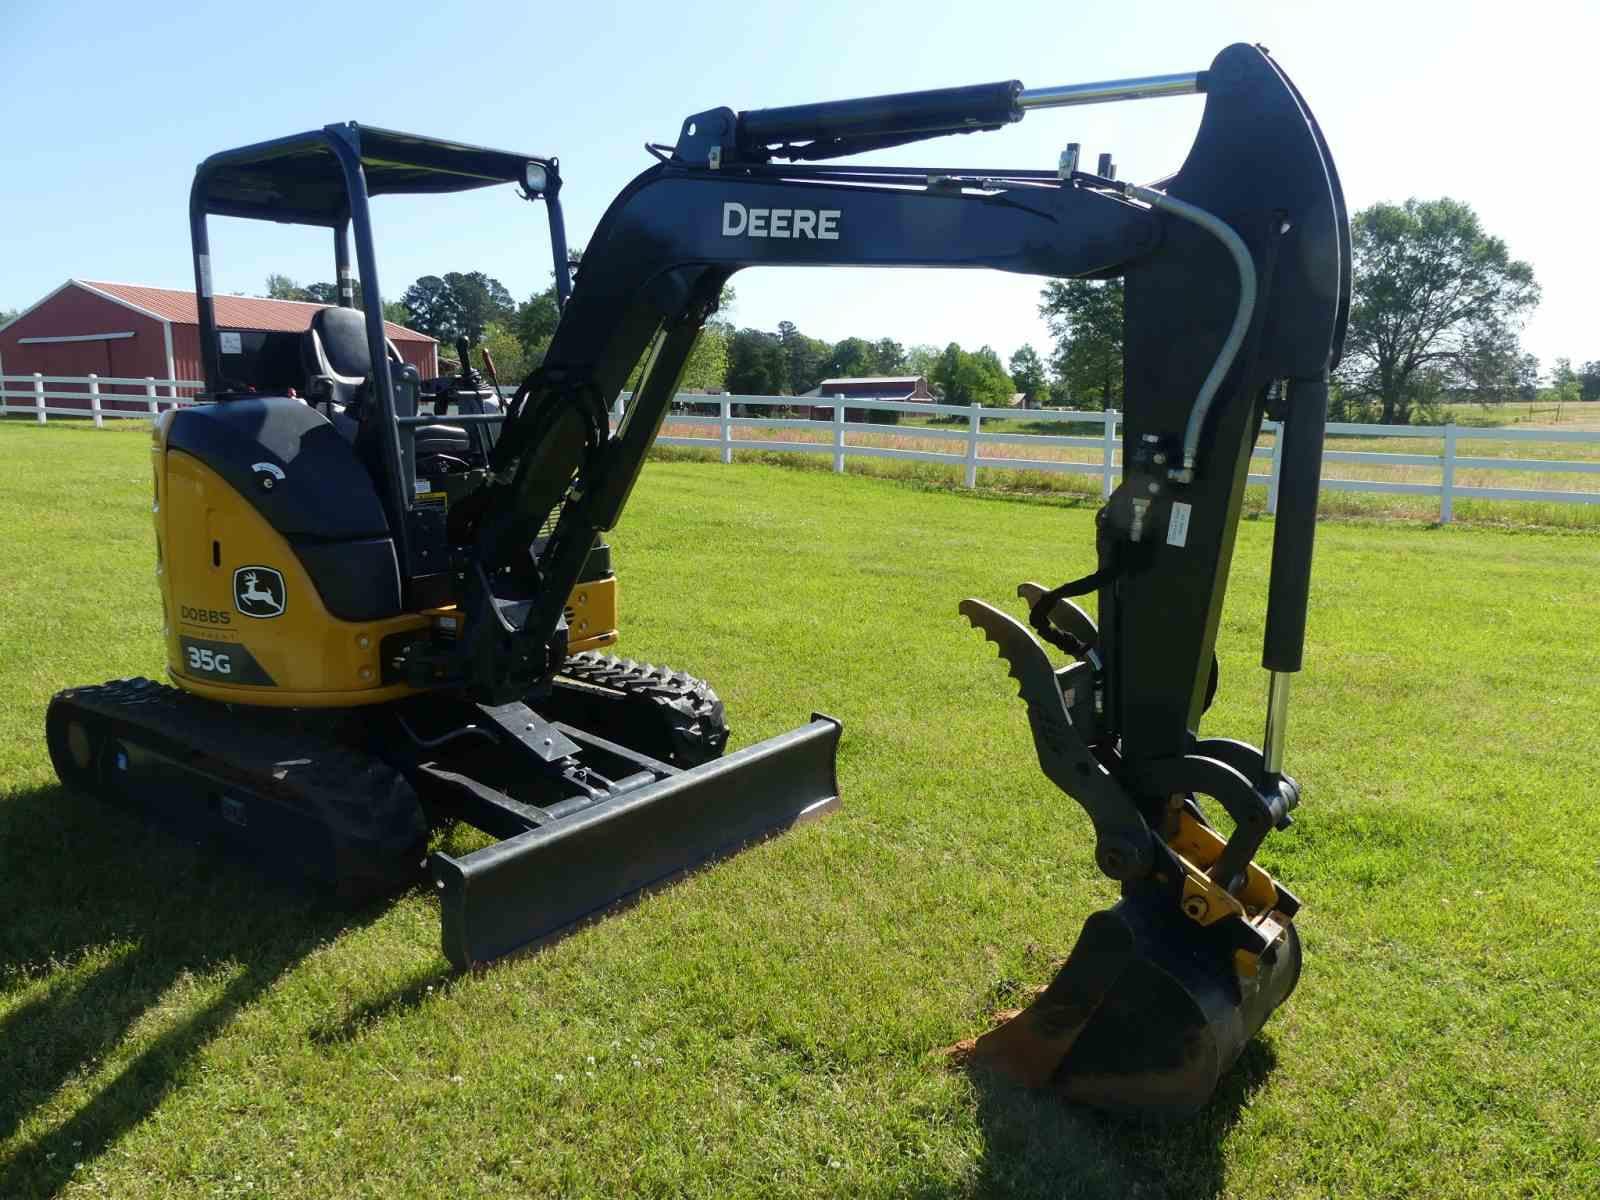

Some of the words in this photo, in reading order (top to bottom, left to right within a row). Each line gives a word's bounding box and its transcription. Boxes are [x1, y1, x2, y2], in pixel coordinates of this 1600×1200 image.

[722, 202, 841, 240] DEERE
[181, 605, 231, 625] DOBBS
[187, 646, 231, 674] 35G
